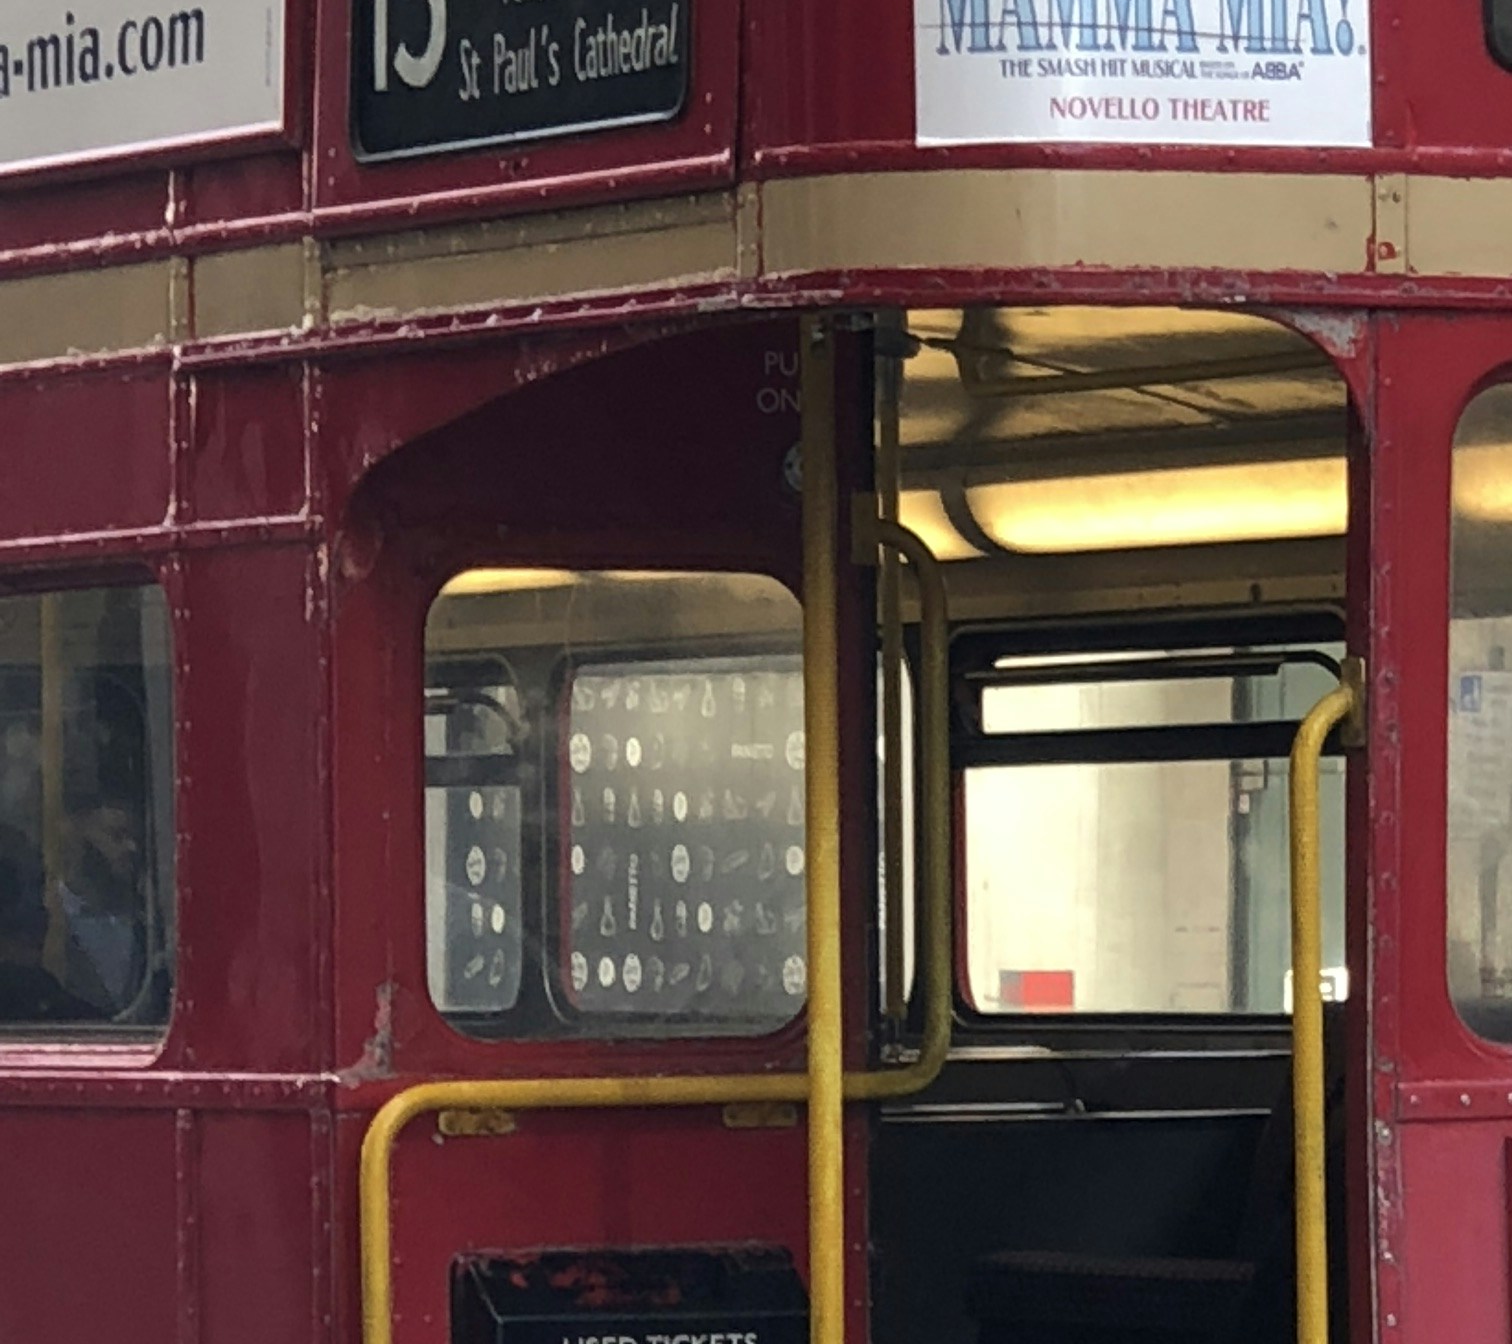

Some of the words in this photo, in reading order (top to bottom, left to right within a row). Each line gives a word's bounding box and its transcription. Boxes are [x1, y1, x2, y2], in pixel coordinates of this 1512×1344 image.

[459, 39, 481, 101] St
[494, 30, 560, 95] Paul's
[575, 4, 678, 82] Cathedral
[999, 59, 1033, 78] THE
[1039, 58, 1096, 78] SMASH
[1101, 59, 1127, 79] HIT
[1131, 60, 1198, 80] MUSICAL
[1050, 97, 1159, 121] NOVELLO
[1171, 98, 1270, 122] THEATRE
[764, 351, 799, 376] PU
[756, 387, 802, 413] ON
